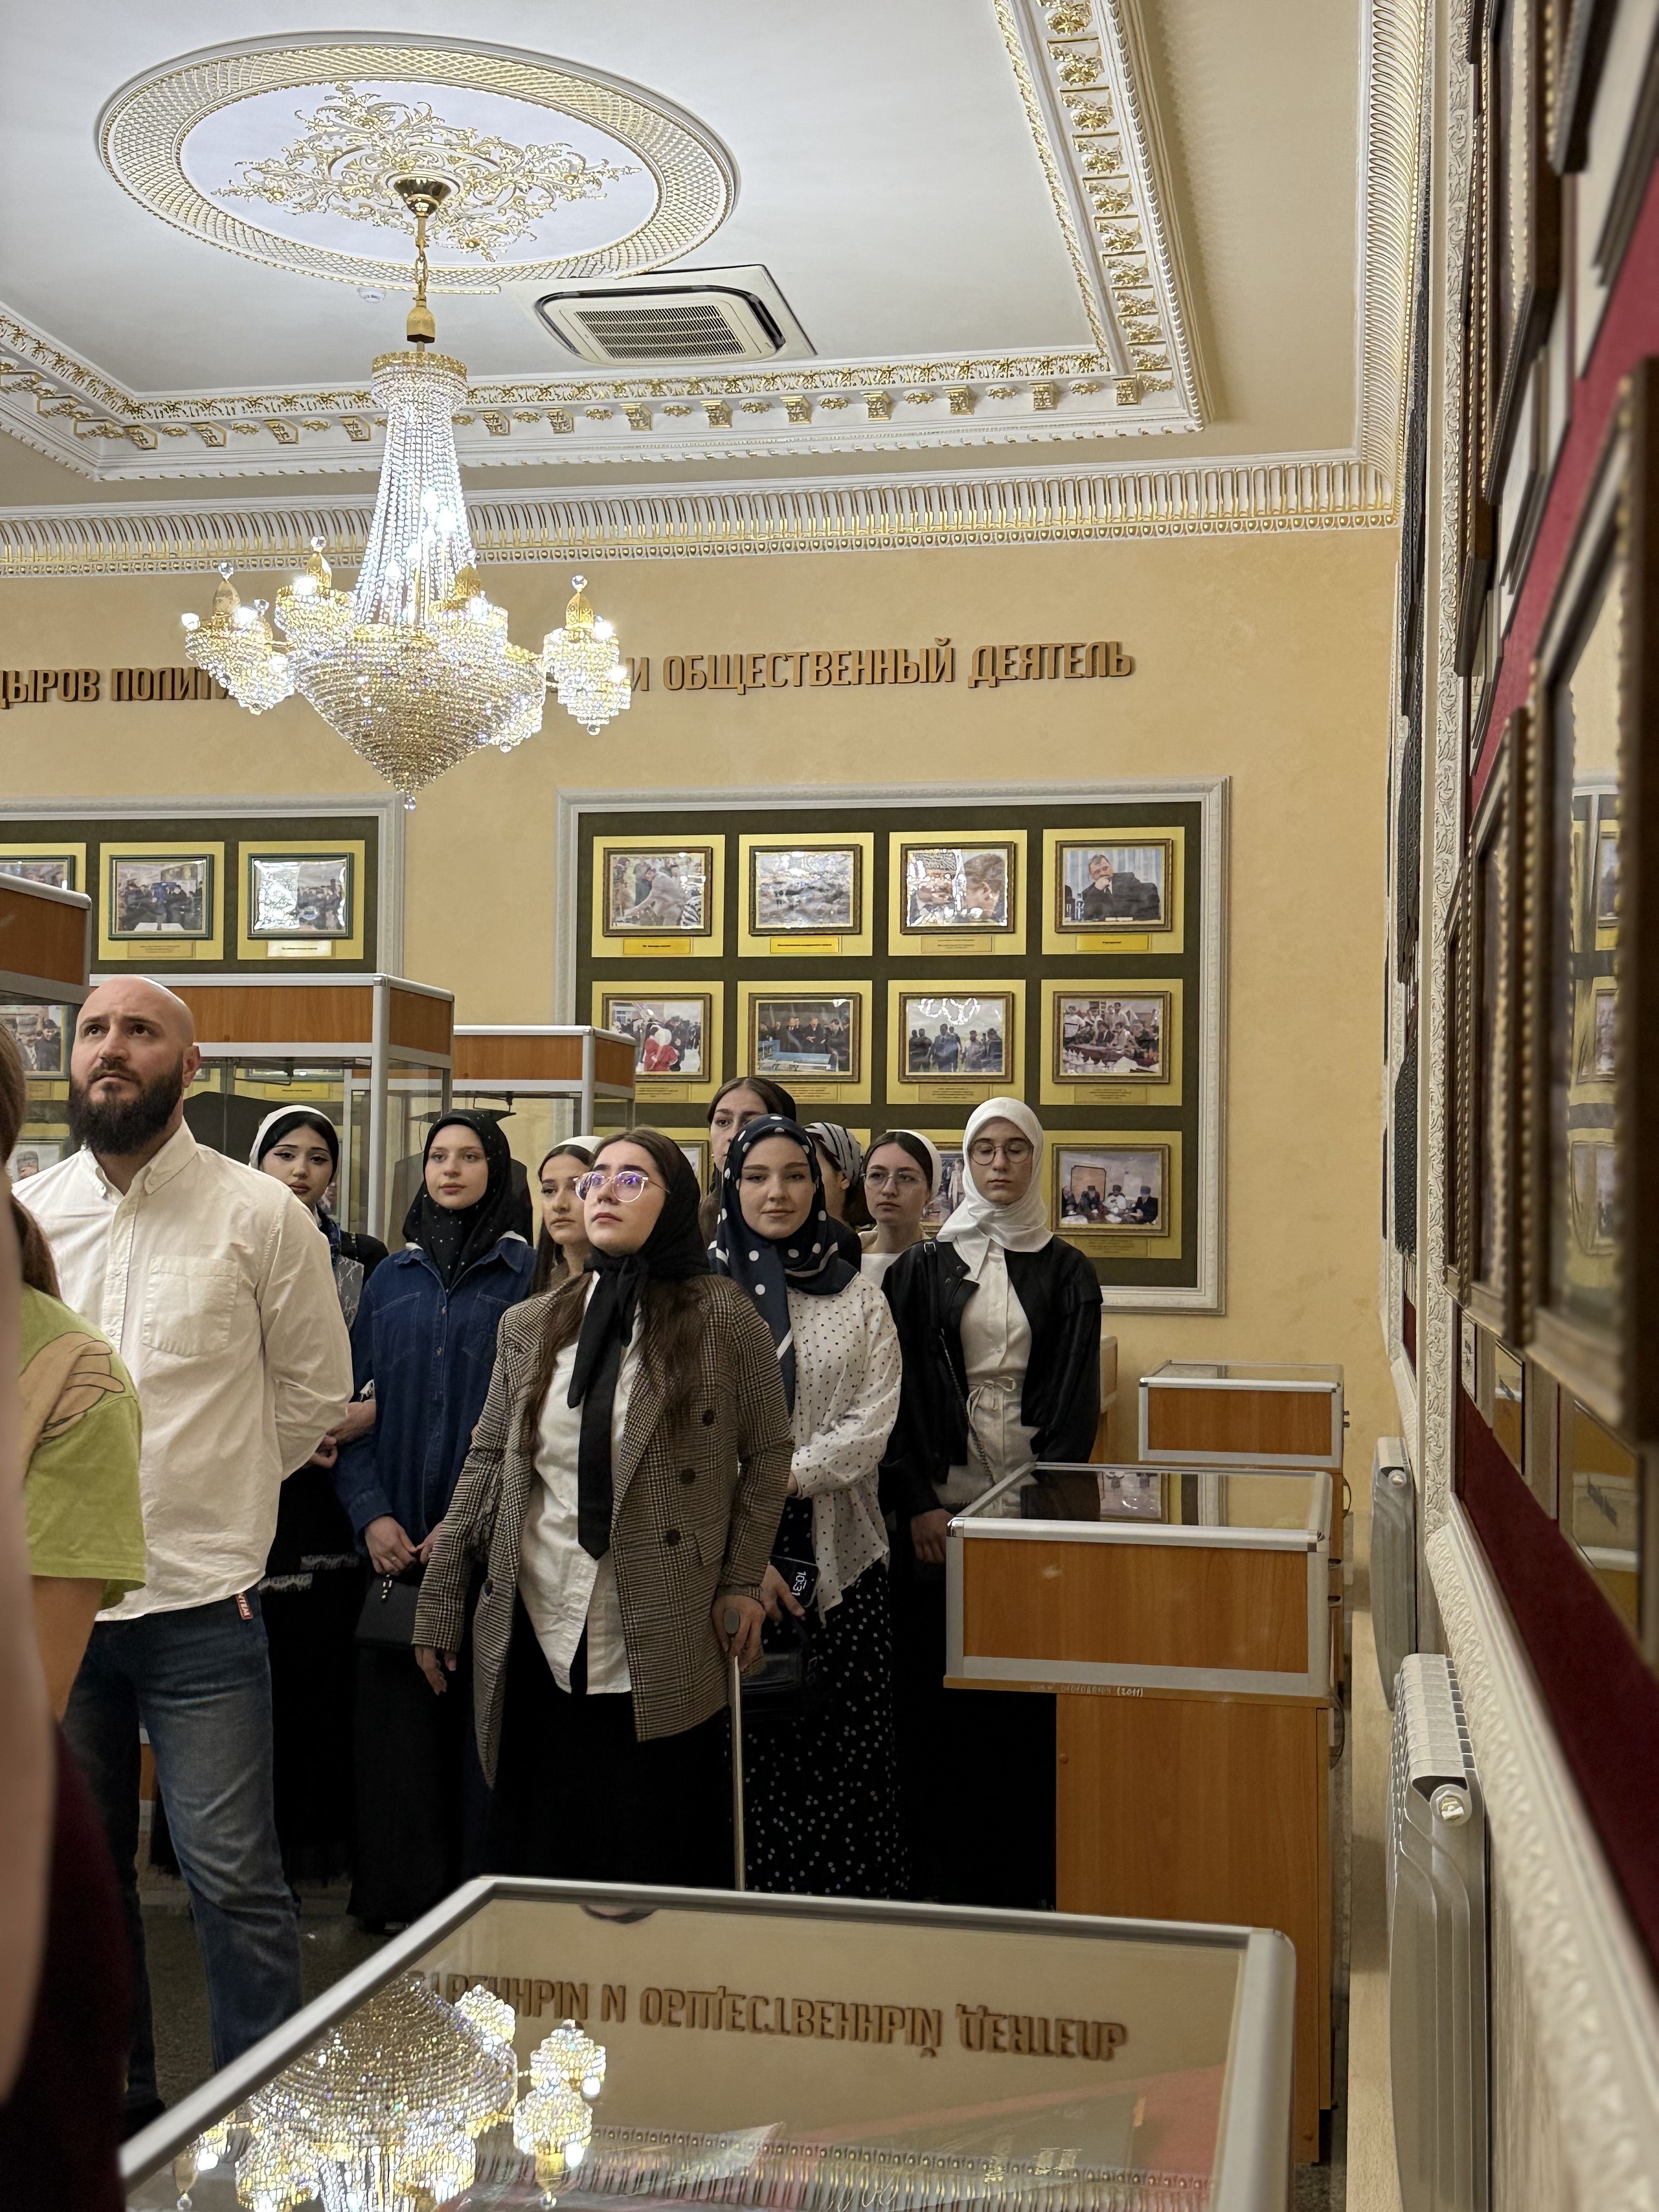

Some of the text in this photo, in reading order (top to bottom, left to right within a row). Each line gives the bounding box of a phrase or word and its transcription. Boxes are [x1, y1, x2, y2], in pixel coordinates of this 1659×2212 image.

[625, 657, 649, 691] И
[663, 637, 955, 695] ОБЩЕСТВЕННЫЙ
[968, 641, 1135, 688] ДЕЯТЕЛЬ
[1116, 1686, 1143, 1698] (2011)
